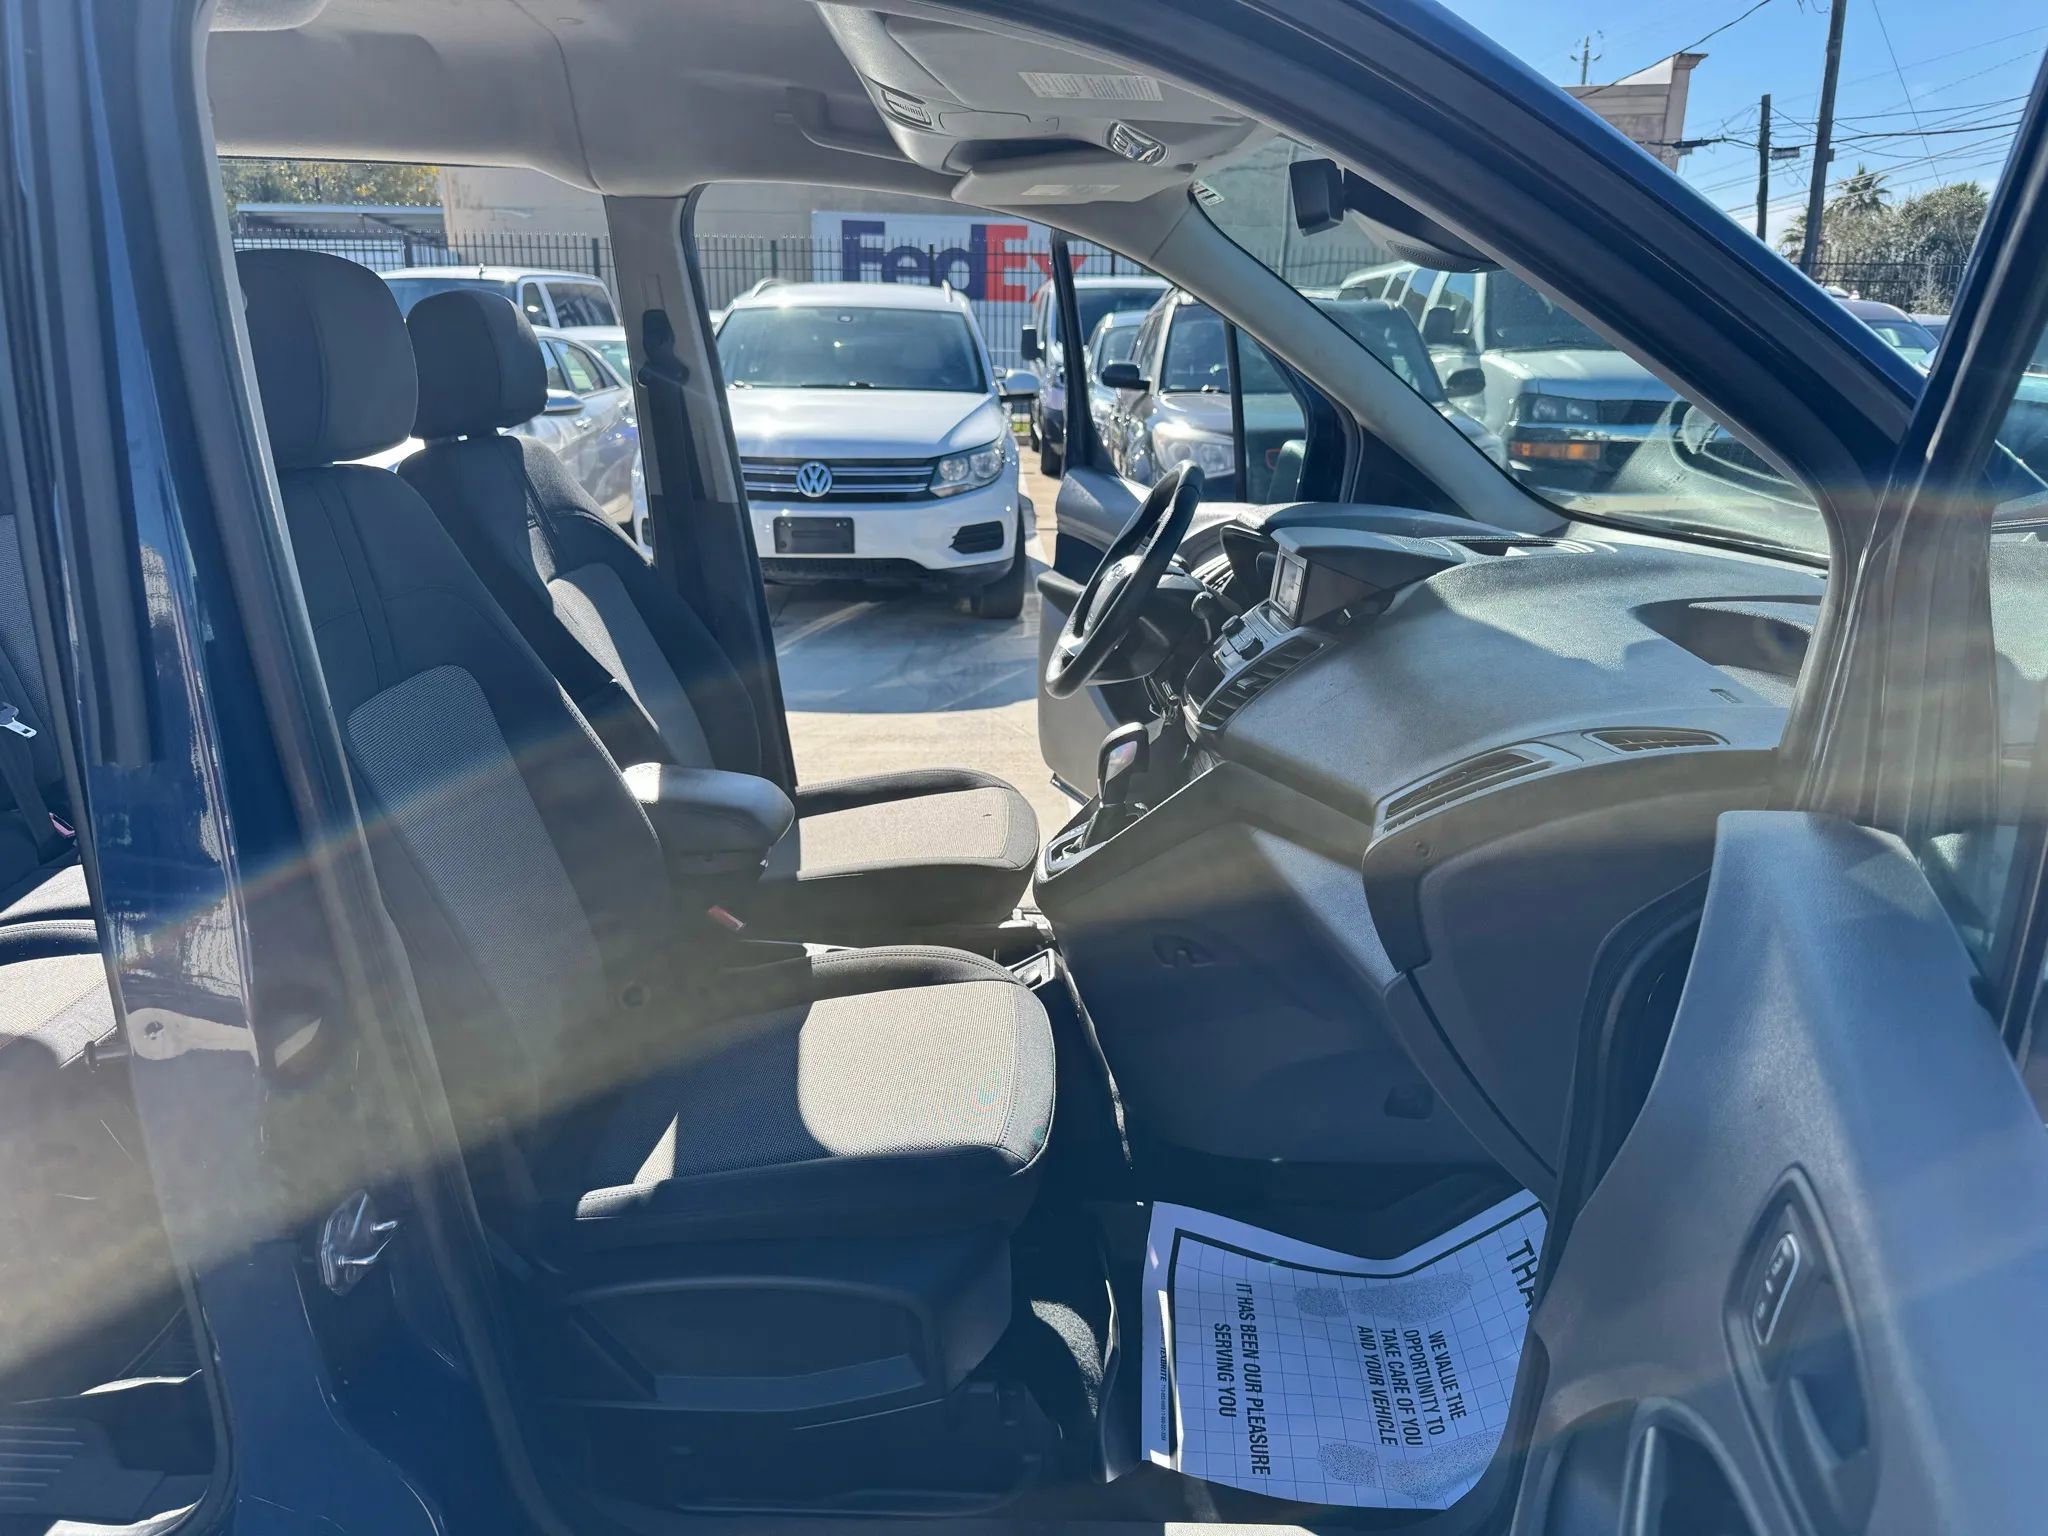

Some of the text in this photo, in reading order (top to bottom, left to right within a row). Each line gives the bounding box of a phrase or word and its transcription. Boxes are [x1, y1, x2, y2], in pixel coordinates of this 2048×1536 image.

[1506, 1239, 1537, 1315] THA
[1214, 1323, 1237, 1417] SERVING YOU
[1236, 1283, 1271, 1475] IT HAS BEEN OUR PLEASURE
[1357, 1325, 1399, 1446] AND YOUR VEHICLE
[1380, 1328, 1424, 1446] TAKE CARE OF YOU
[1403, 1329, 1446, 1435] OPPORTUNITY TO
[1428, 1330, 1467, 1421] WE VALUE THE
